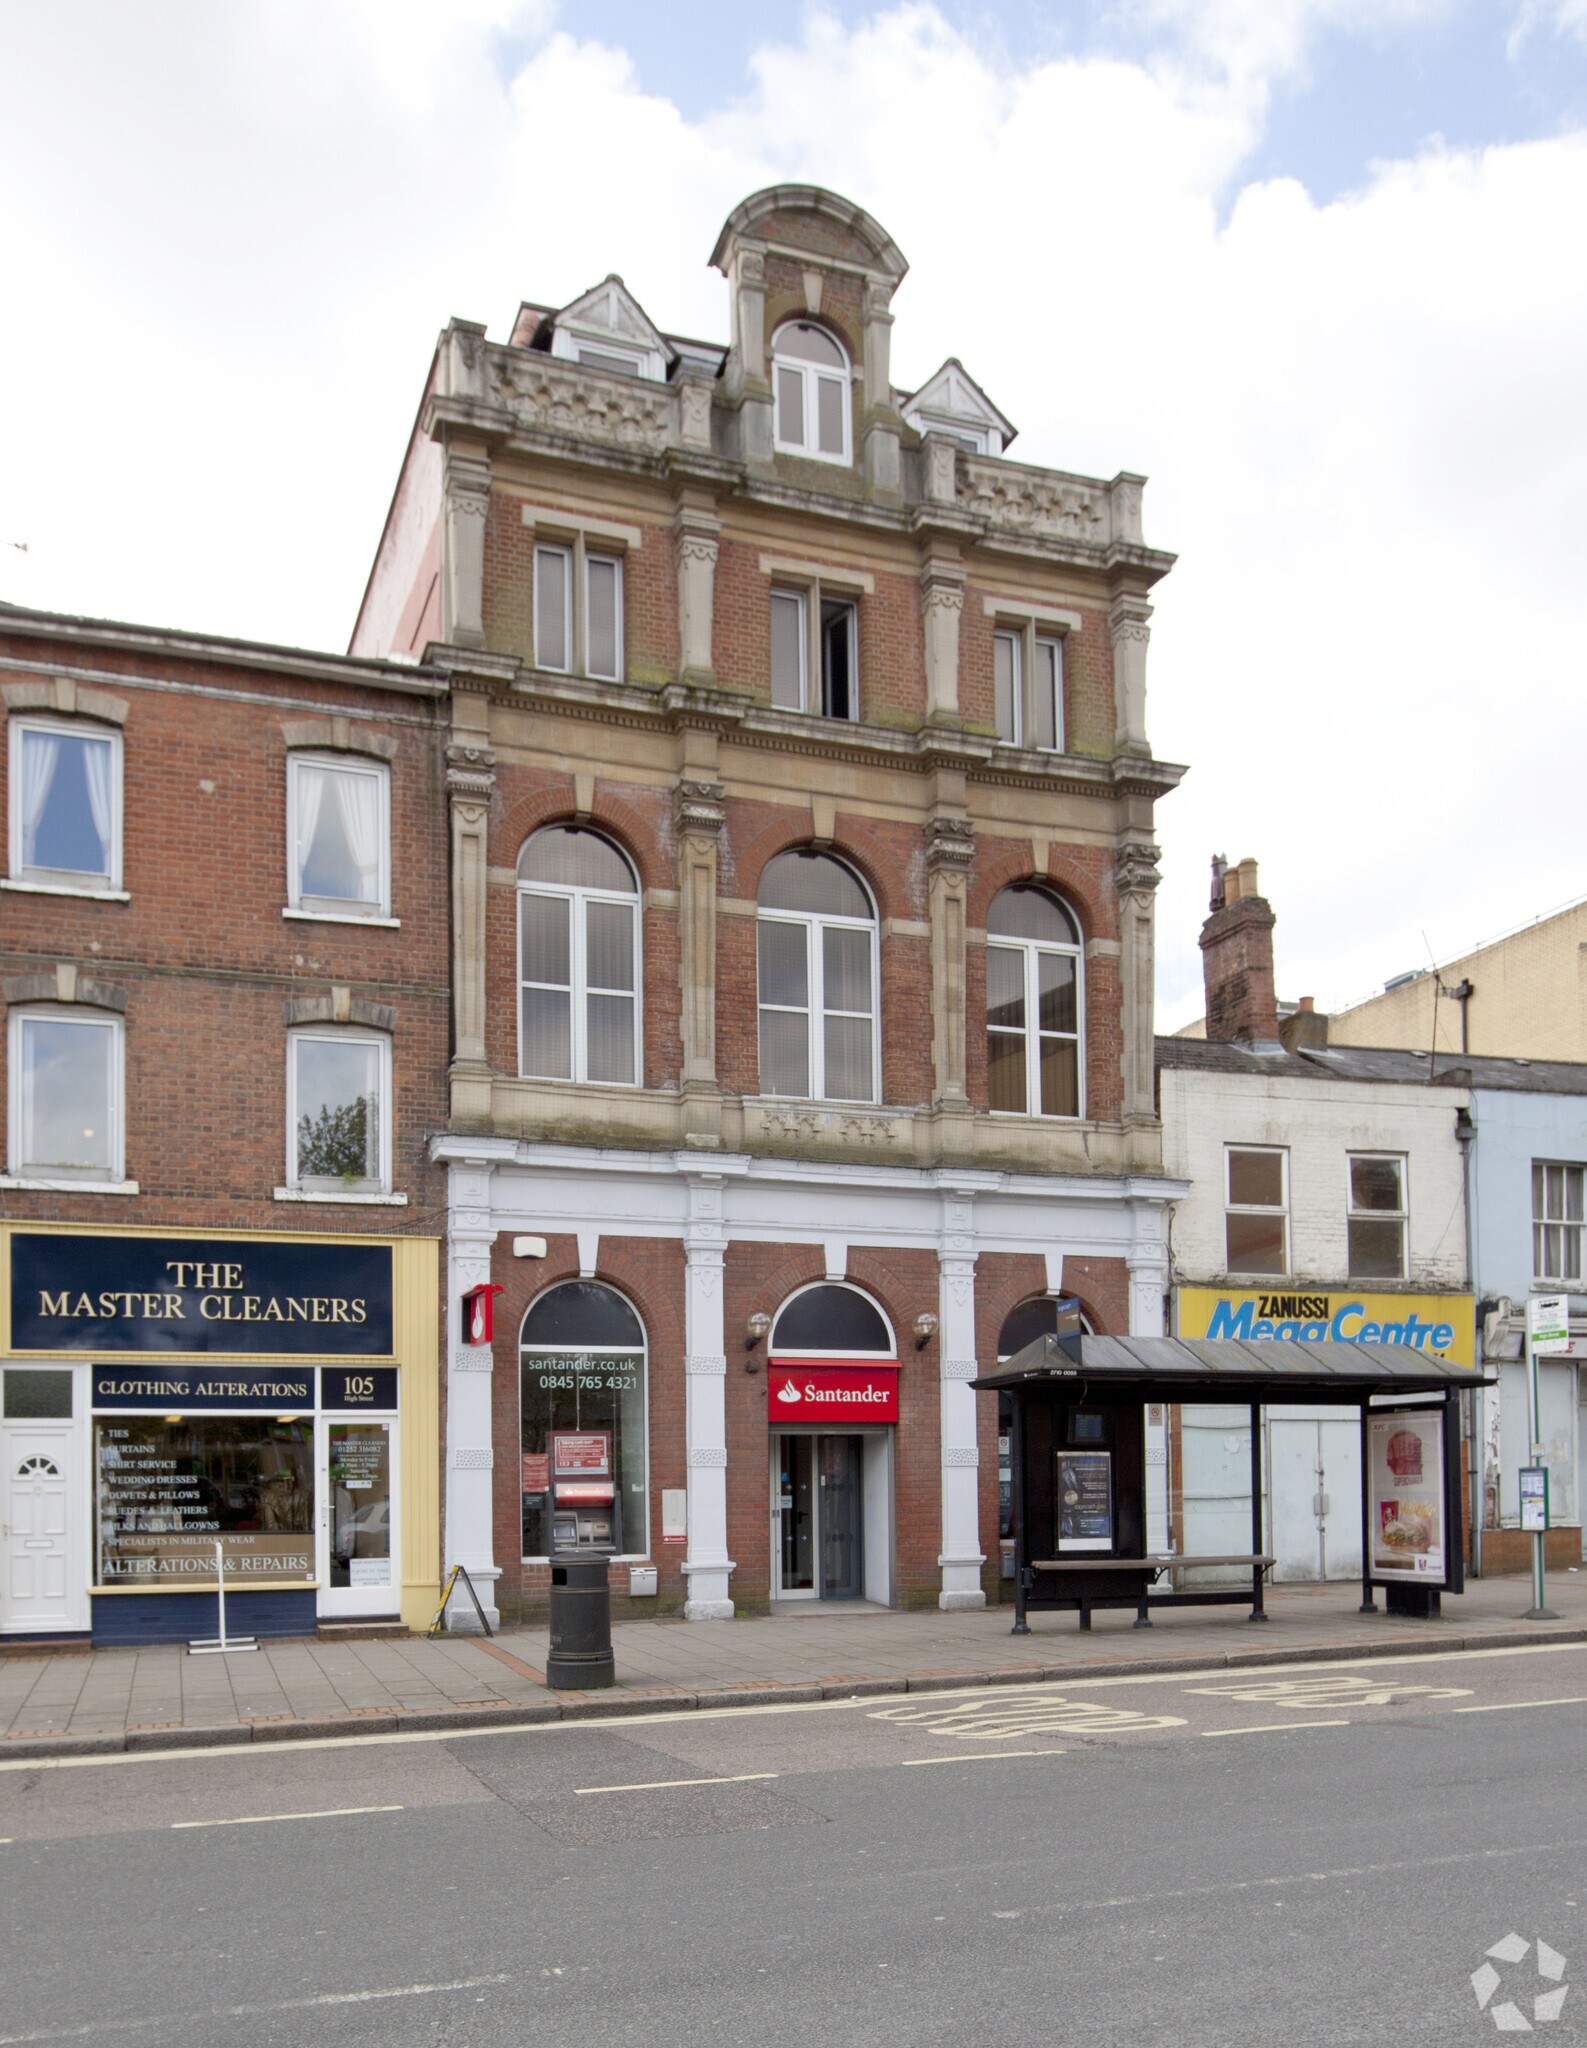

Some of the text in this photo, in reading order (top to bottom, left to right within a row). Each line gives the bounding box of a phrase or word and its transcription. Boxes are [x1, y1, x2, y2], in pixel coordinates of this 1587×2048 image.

[166, 1261, 243, 1290] THE
[38, 1290, 367, 1323] MASTER CLEANERS
[1258, 1295, 1329, 1319] ZANUSSI
[528, 1358, 636, 1371] santander.co.uk
[98, 1380, 308, 1397] CLOTHING ALTERATIONS
[344, 1376, 374, 1395] 105
[540, 1375, 637, 1389] 0845 765 4321
[804, 1384, 890, 1403] Santander
[108, 1429, 129, 1438] TIES
[108, 1460, 177, 1469] SHIRT SERVICE
[108, 1475, 198, 1484] WEDDING DRESSES
[108, 1491, 147, 1500] DUVETS
[158, 1490, 200, 1499] PILLOWS
[160, 1506, 208, 1514] LEATHERS
[109, 1536, 256, 1546] SPECIALISTS IN MILITARY WEAR
[103, 1557, 308, 1574] ALTERATIONS & REPAIRS
